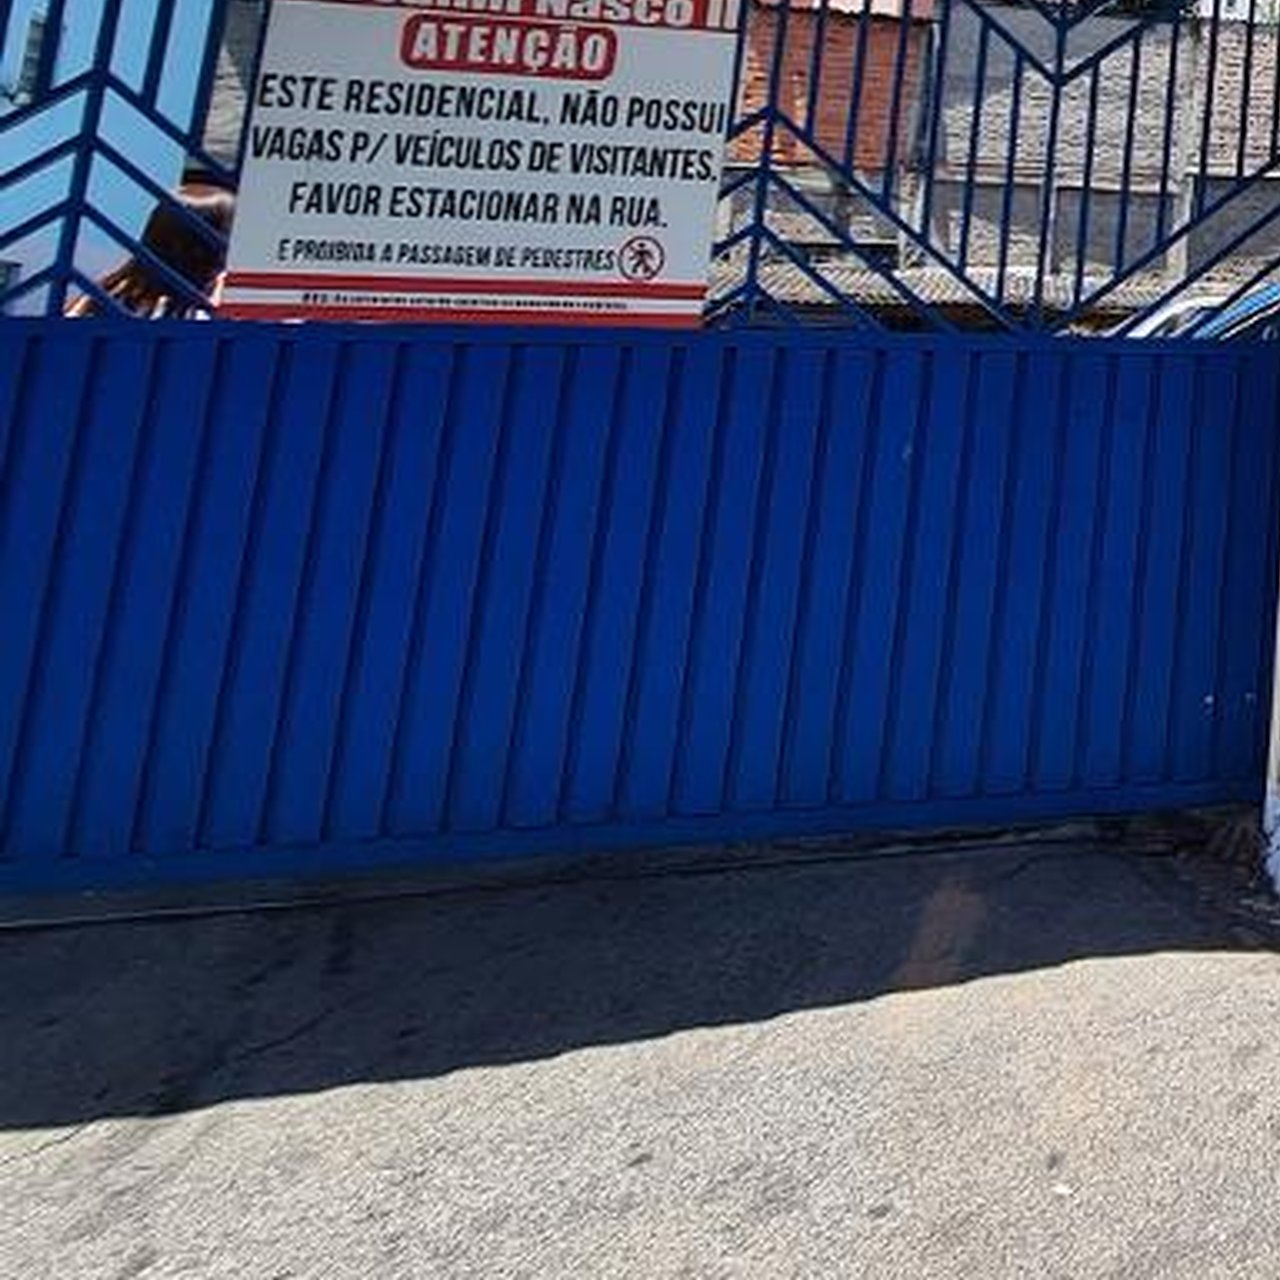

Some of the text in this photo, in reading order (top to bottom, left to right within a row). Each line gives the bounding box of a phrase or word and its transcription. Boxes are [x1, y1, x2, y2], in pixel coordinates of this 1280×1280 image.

[411, 22, 608, 73] ATENÇÃO
[258, 73, 337, 111] ESTE
[559, 89, 618, 128] NÃO
[626, 96, 726, 134] POSSUI
[252, 126, 717, 182] VAGAS P/ VEÍCULOS DE VISITANTES.
[288, 182, 667, 229] FAVOR ESTACIONAR NA RUA.
[379, 242, 393, 263] A
[398, 242, 491, 267] PASSAGEM
[493, 246, 516, 268] DE
[519, 247, 615, 271] PEDESTRES
